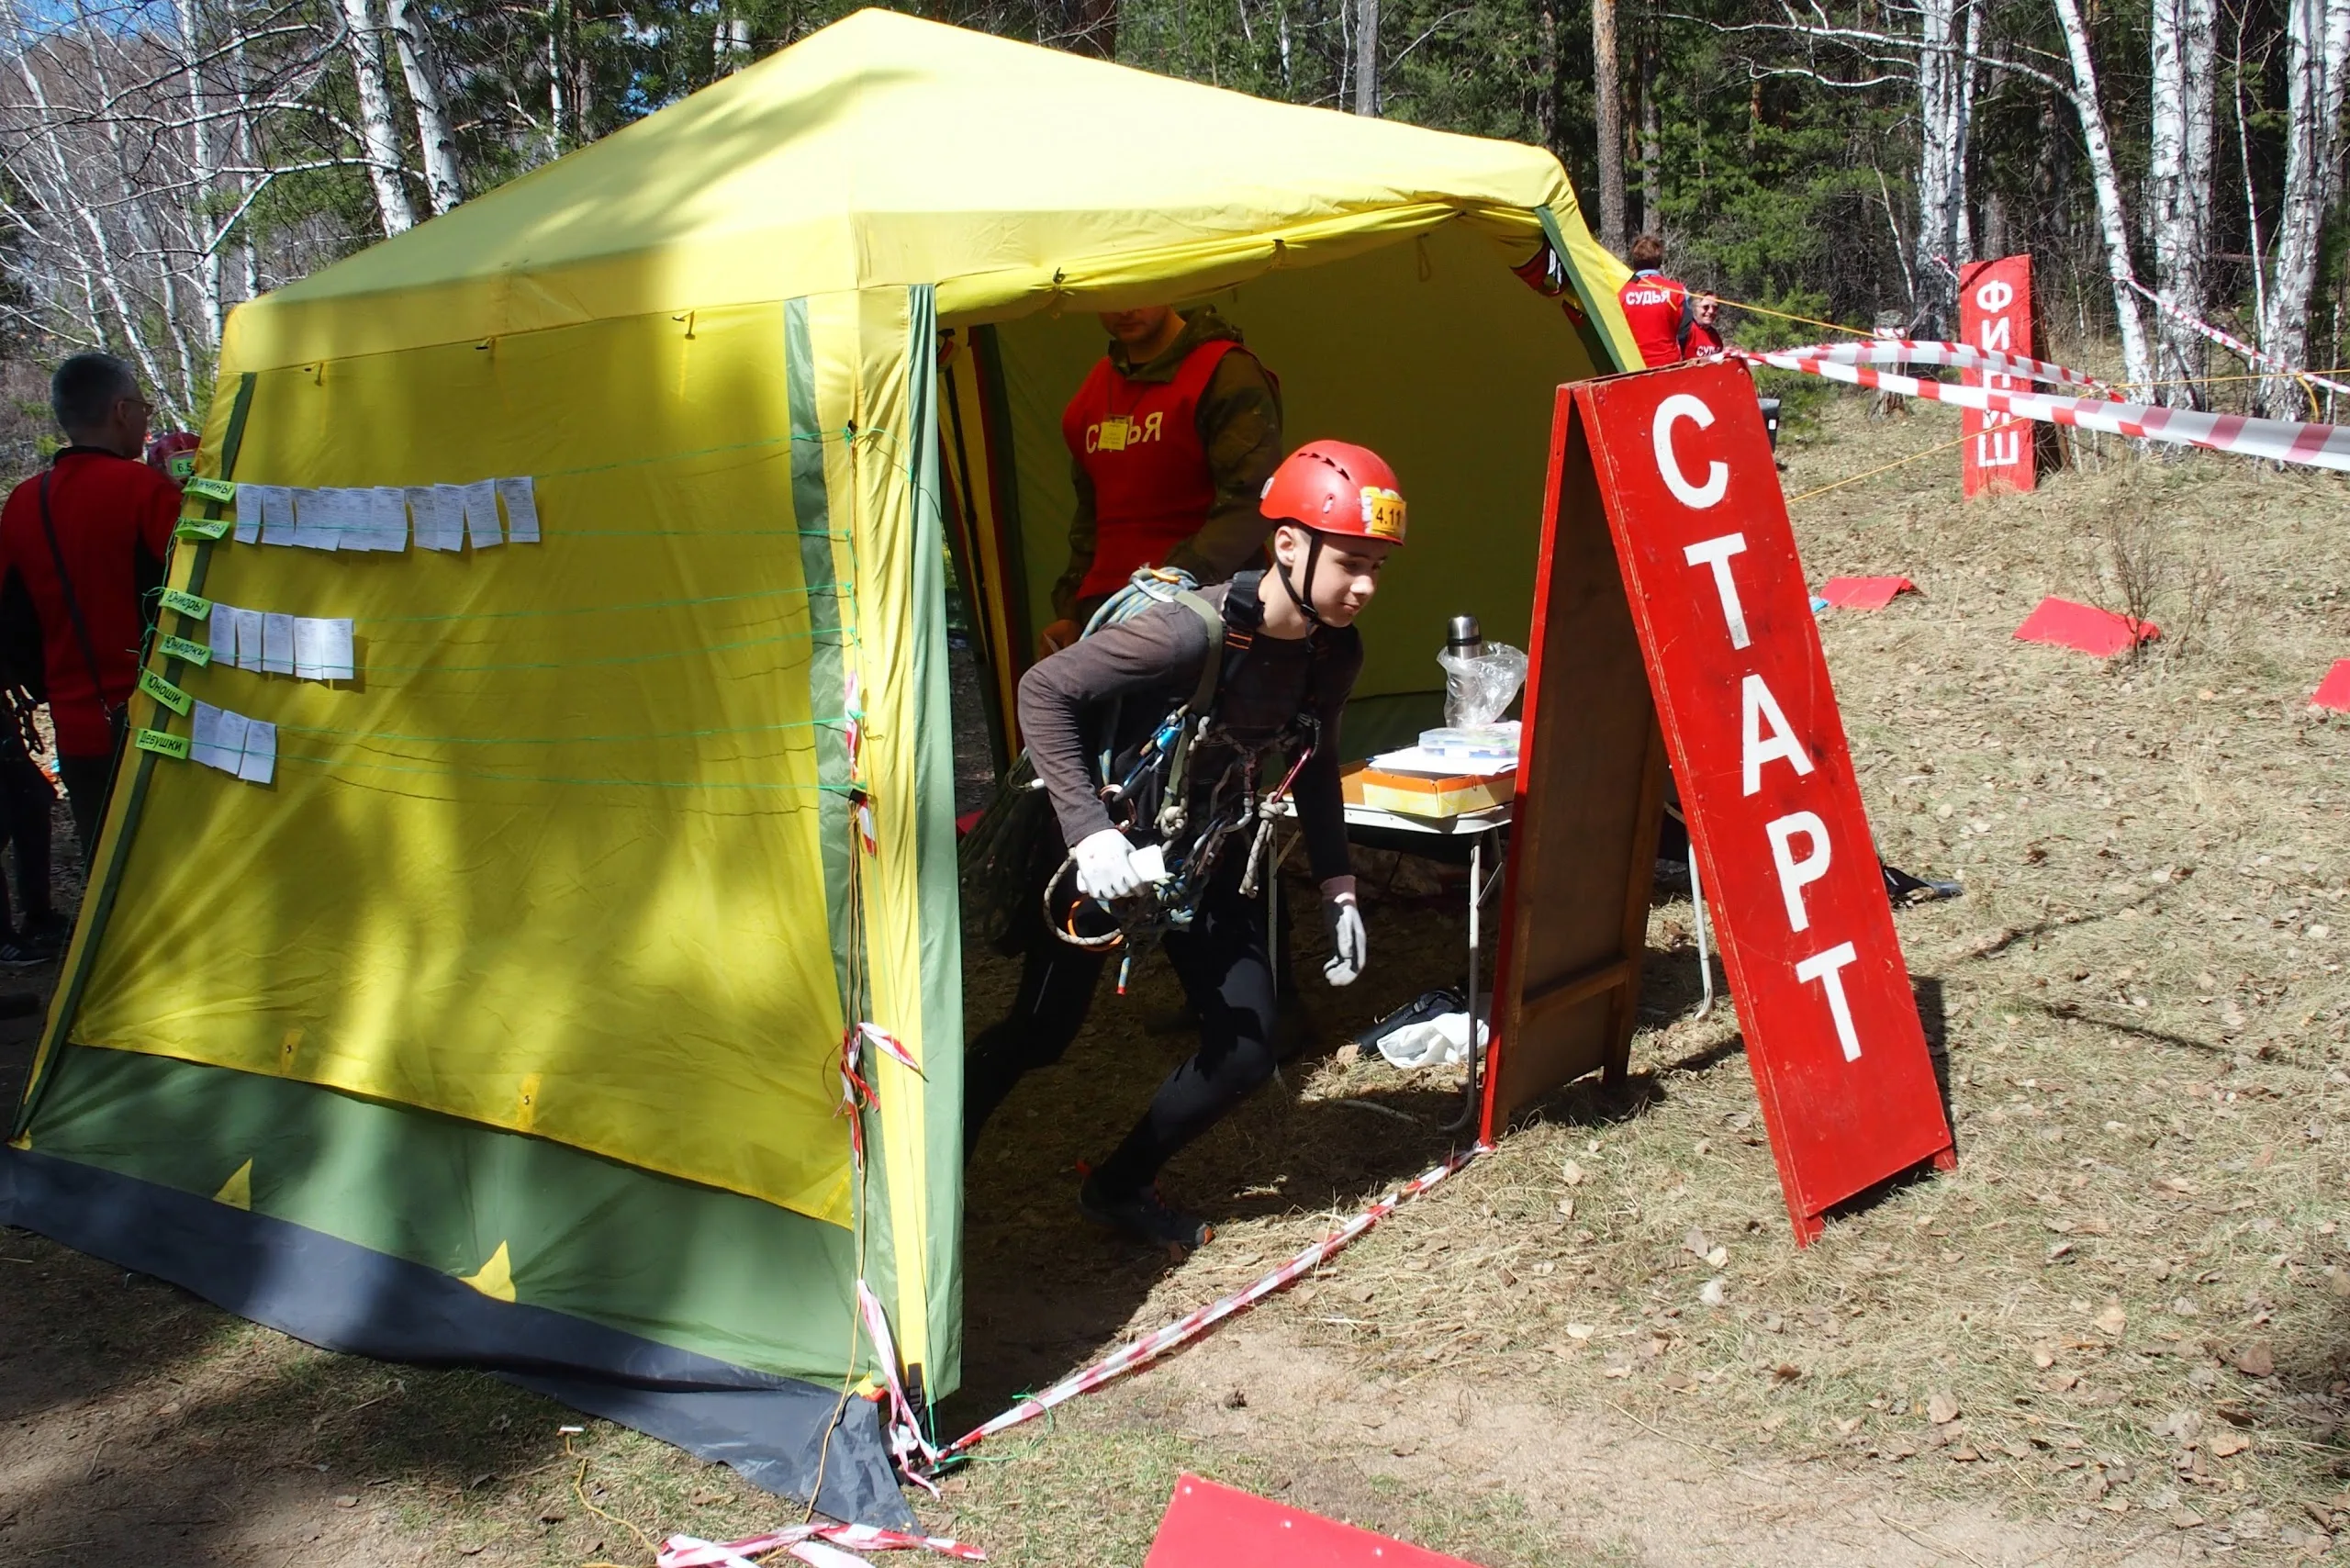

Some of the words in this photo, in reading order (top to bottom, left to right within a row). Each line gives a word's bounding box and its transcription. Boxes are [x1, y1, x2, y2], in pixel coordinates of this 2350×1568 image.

[1625, 289, 1671, 306] СУДЬЯ
[1695, 345, 1720, 357] СУД
[1086, 411, 1163, 454] СЬЯ
[185, 476, 233, 496] Мчины
[1375, 506, 1402, 526] 4.11
[167, 591, 204, 613] Юниоры
[165, 635, 207, 659] Юниорки
[147, 674, 182, 705] Юноши
[1652, 394, 1863, 1063] СТАРТ
[140, 730, 183, 753] Девушки
